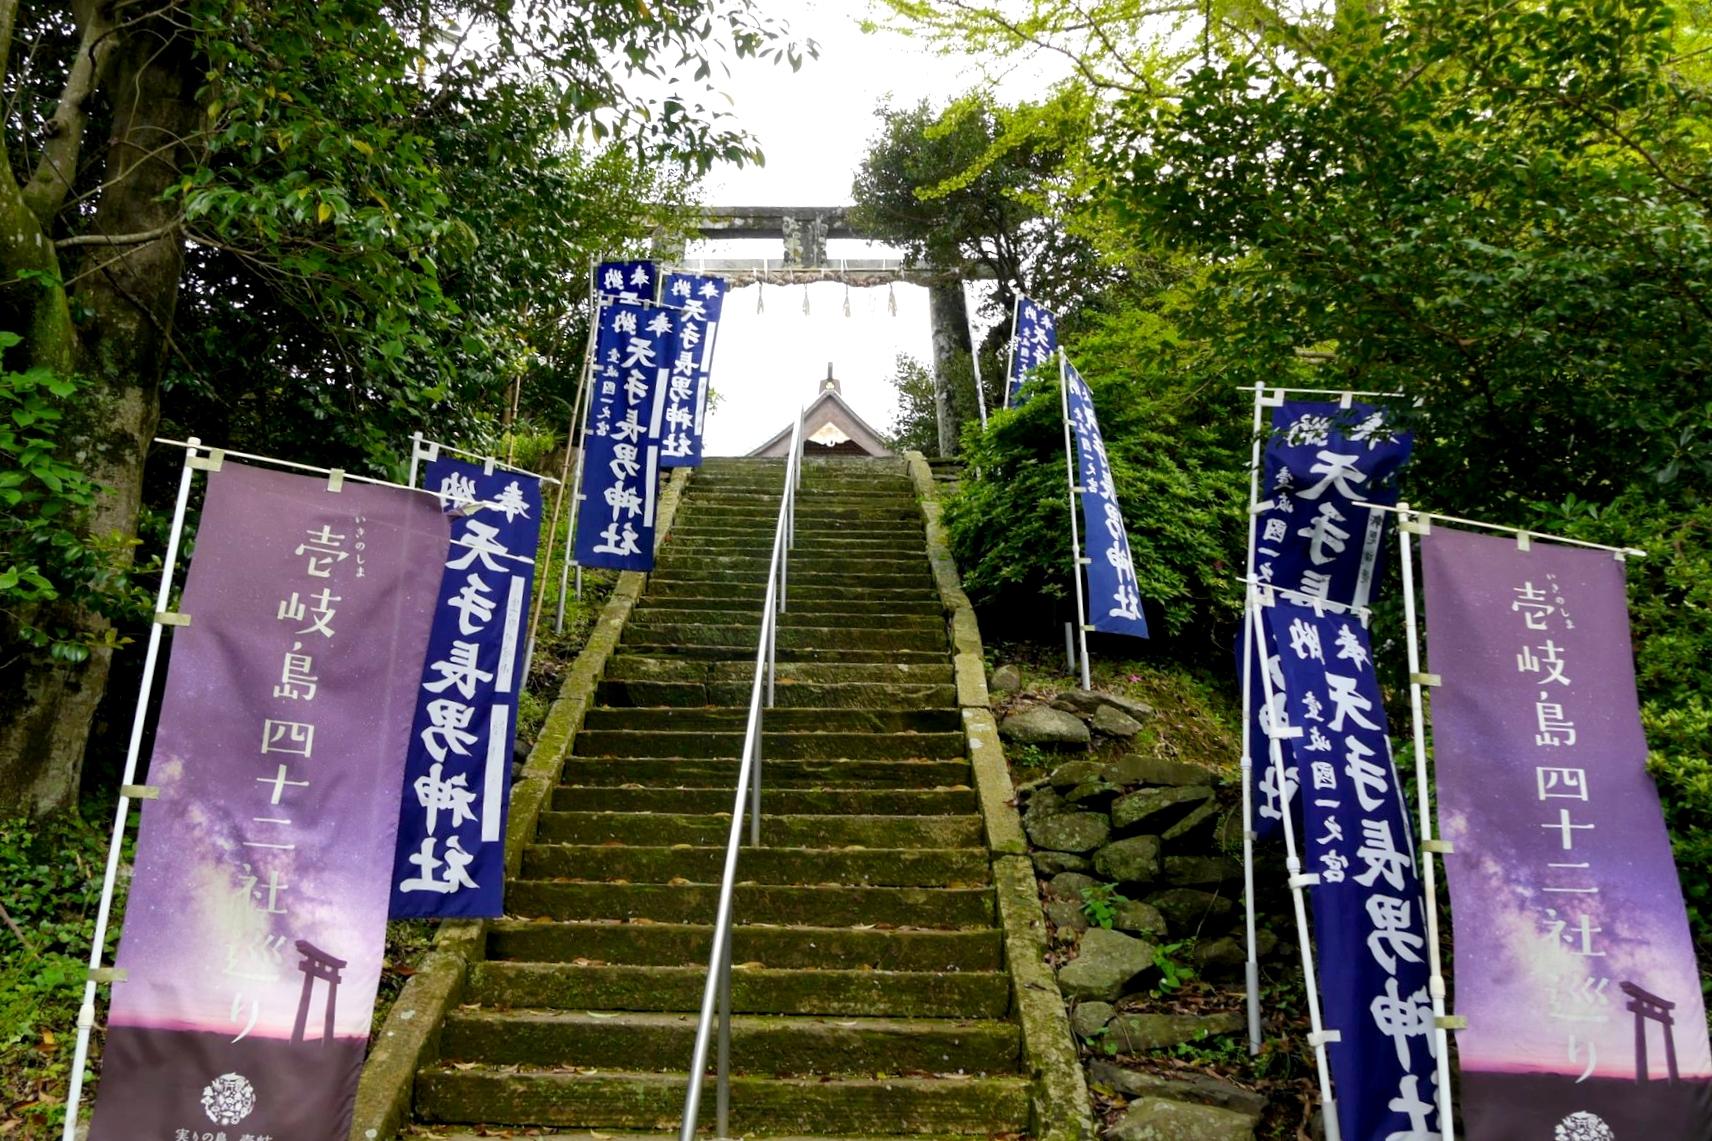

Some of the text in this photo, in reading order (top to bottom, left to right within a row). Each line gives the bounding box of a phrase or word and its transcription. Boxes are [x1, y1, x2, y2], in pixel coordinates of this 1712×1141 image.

[223, 524, 349, 1043] 壱岐島四十二社巡り
[355, 515, 366, 578] いきのしま
[1511, 581, 1609, 1084] 壱岐島四十二社巡り
